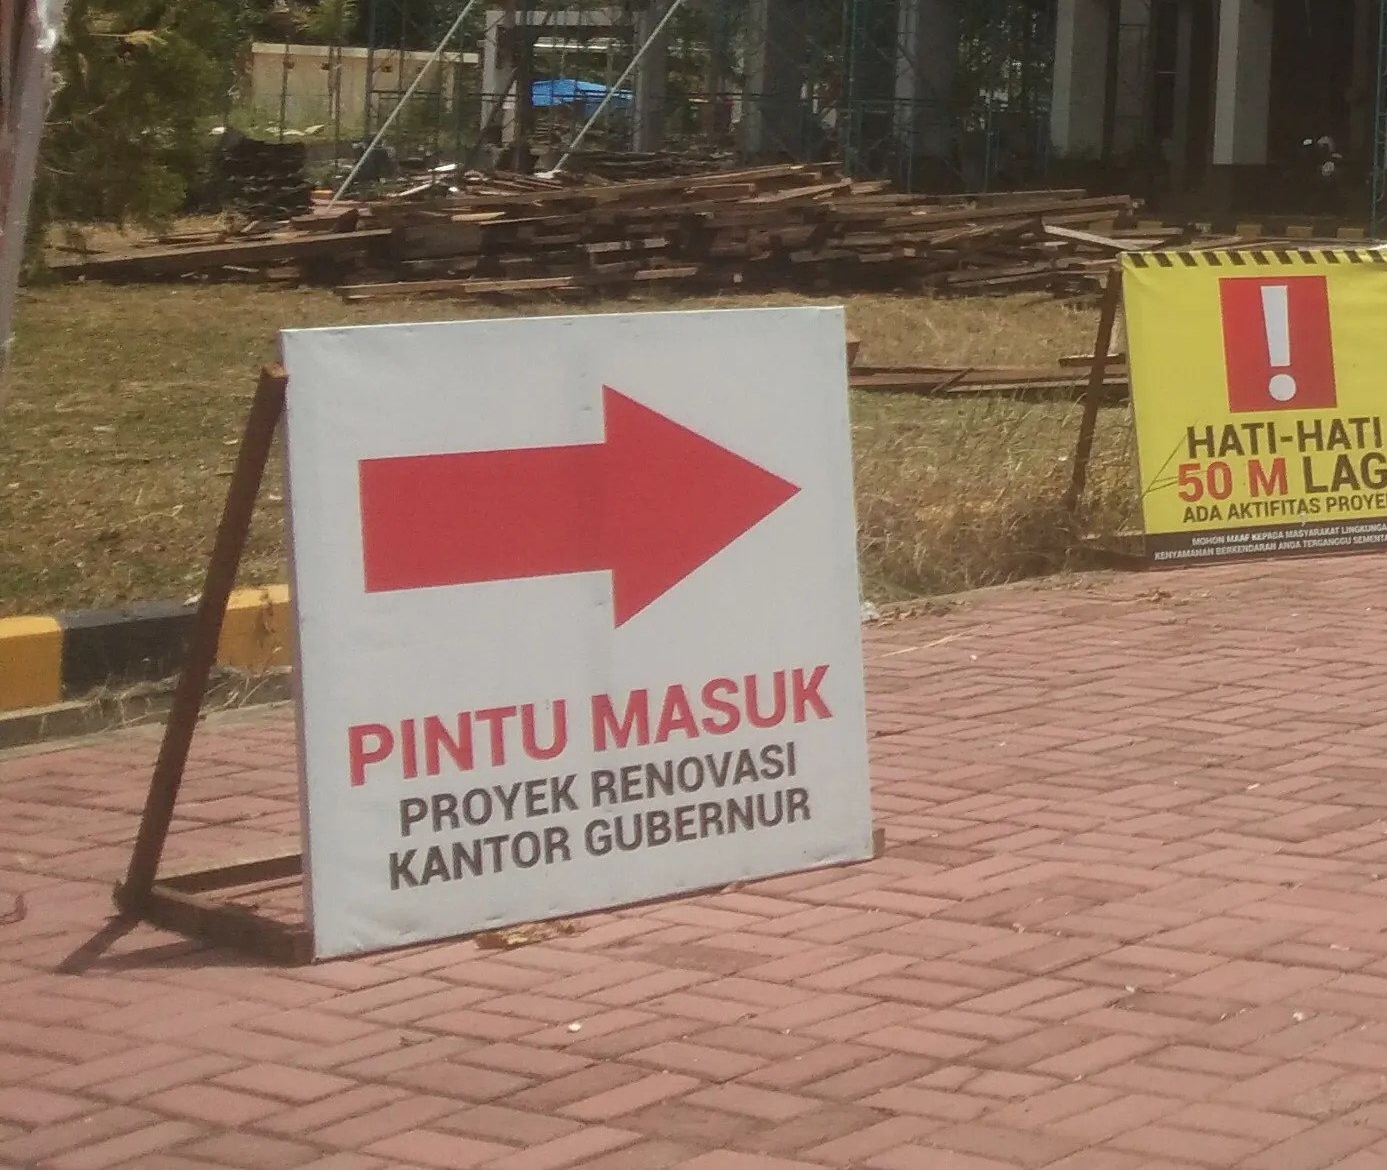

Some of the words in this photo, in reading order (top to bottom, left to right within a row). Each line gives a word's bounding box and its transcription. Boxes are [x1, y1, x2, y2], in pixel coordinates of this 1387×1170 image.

[1186, 416, 1384, 459] HATI-HATI
[1178, 461, 1233, 502] 50
[1247, 457, 1288, 498] M
[1182, 503, 1223, 523] ADA
[1227, 496, 1321, 521] AKTIFITAS
[1154, 548, 1215, 561] KENYAMANAN
[1278, 538, 1301, 549] ANDA
[1303, 536, 1352, 548] TERGANGGU
[1191, 535, 1225, 546] MOHON
[1226, 533, 1250, 543] MAAF
[1251, 530, 1284, 541] KEPADA
[1285, 527, 1340, 538] MASYARAKAT
[348, 699, 568, 786] PINTU
[591, 664, 834, 753] MASUK
[399, 773, 579, 837] PROYEK
[591, 741, 797, 806] RENOVASI
[388, 827, 572, 891] KANTOR
[584, 787, 812, 856] GUBERNUR
